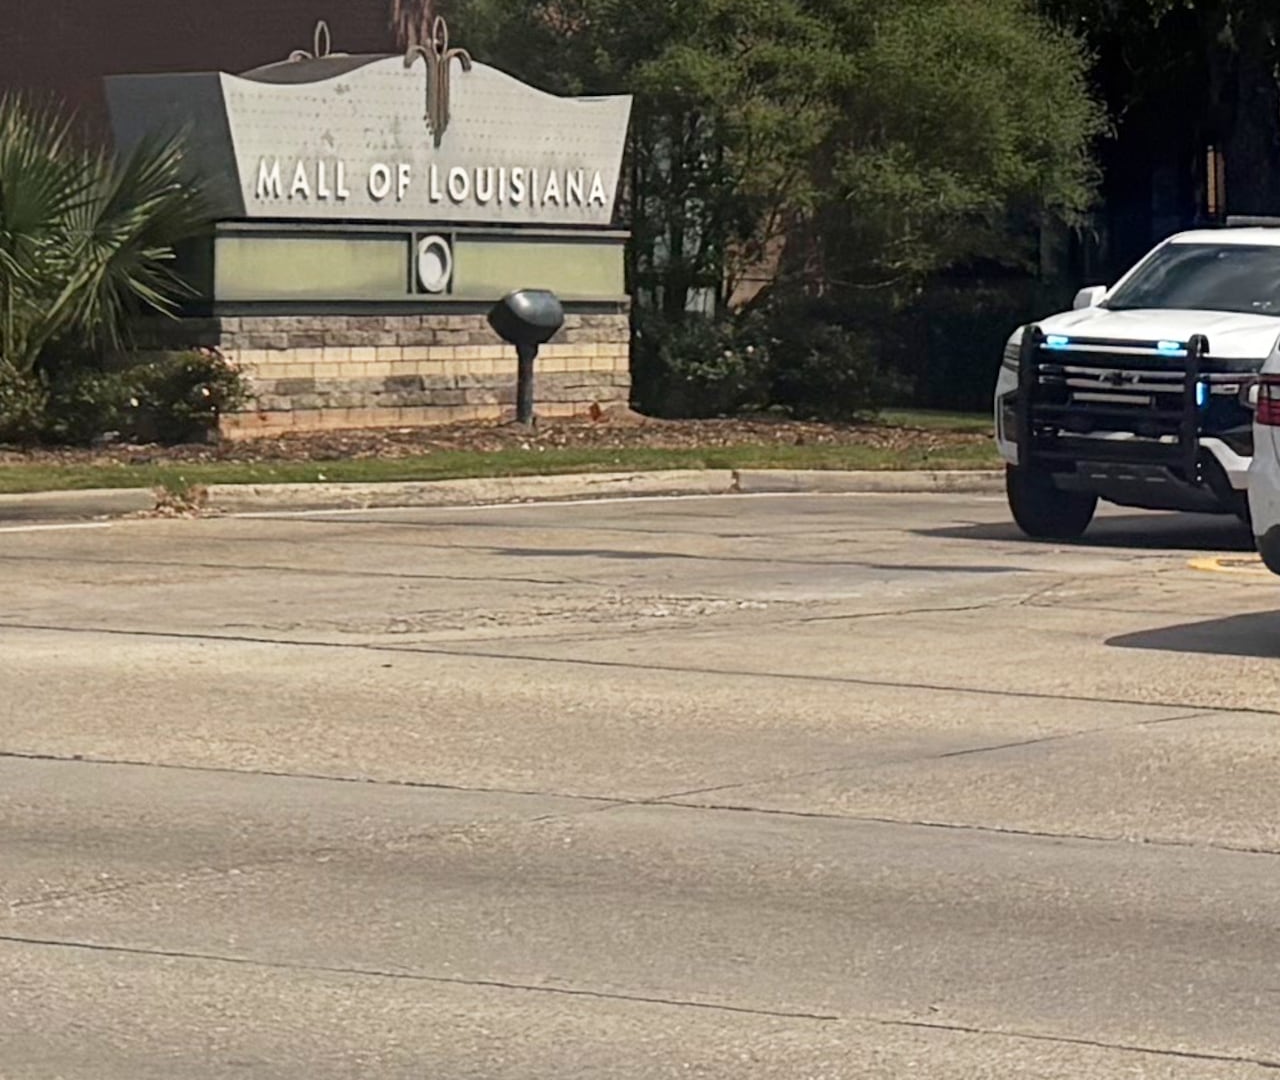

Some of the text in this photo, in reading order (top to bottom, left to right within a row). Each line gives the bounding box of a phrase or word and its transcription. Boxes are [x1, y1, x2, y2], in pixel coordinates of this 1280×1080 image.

[255, 158, 607, 207] MALL OF LOUISIANA
